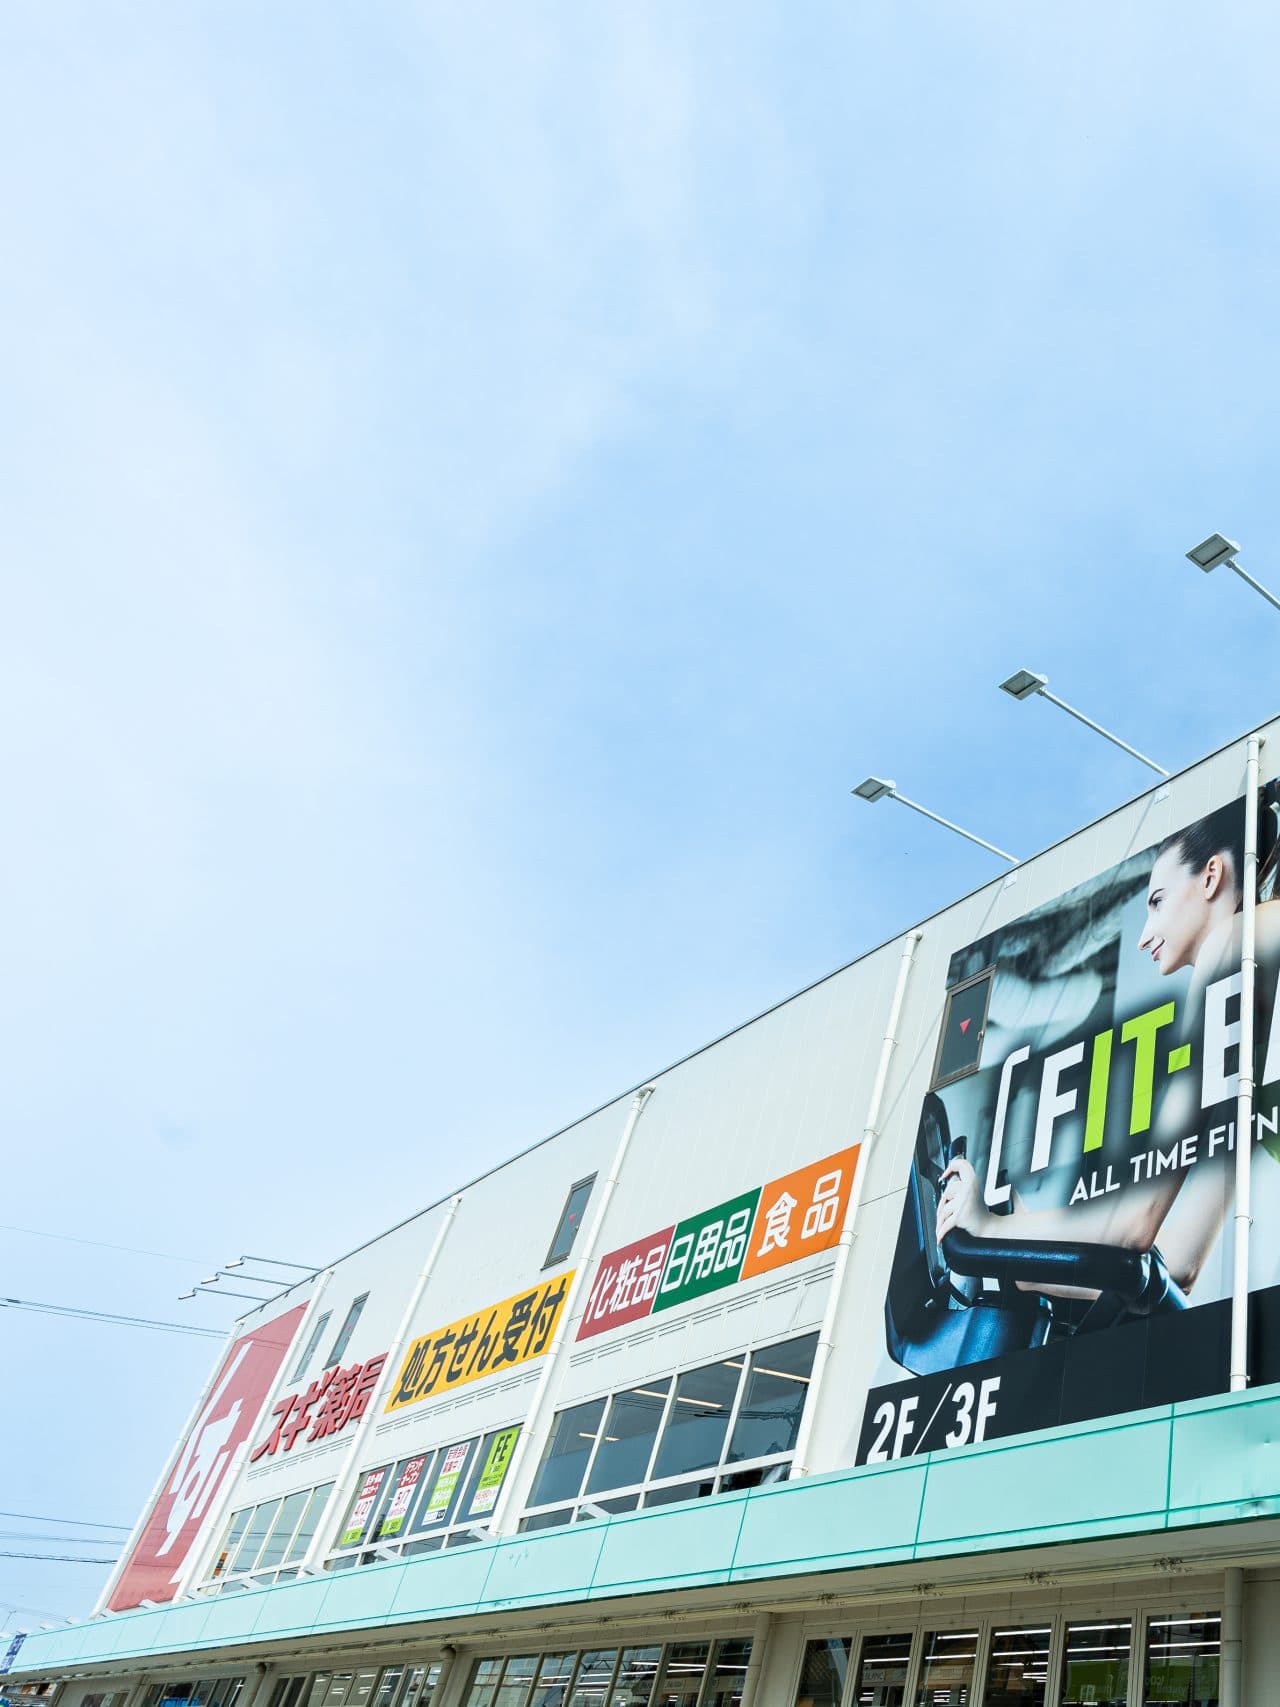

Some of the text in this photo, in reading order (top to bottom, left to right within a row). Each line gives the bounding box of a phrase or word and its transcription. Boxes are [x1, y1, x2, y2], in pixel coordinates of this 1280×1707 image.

[1069, 1165, 1121, 1206] ALL
[1130, 1134, 1199, 1184] TIME
[585, 1244, 667, 1325] 化粧品
[660, 1207, 751, 1294] 日用品
[391, 1277, 567, 1407] 処方せん受付
[250, 1352, 389, 1462] スギ薬局
